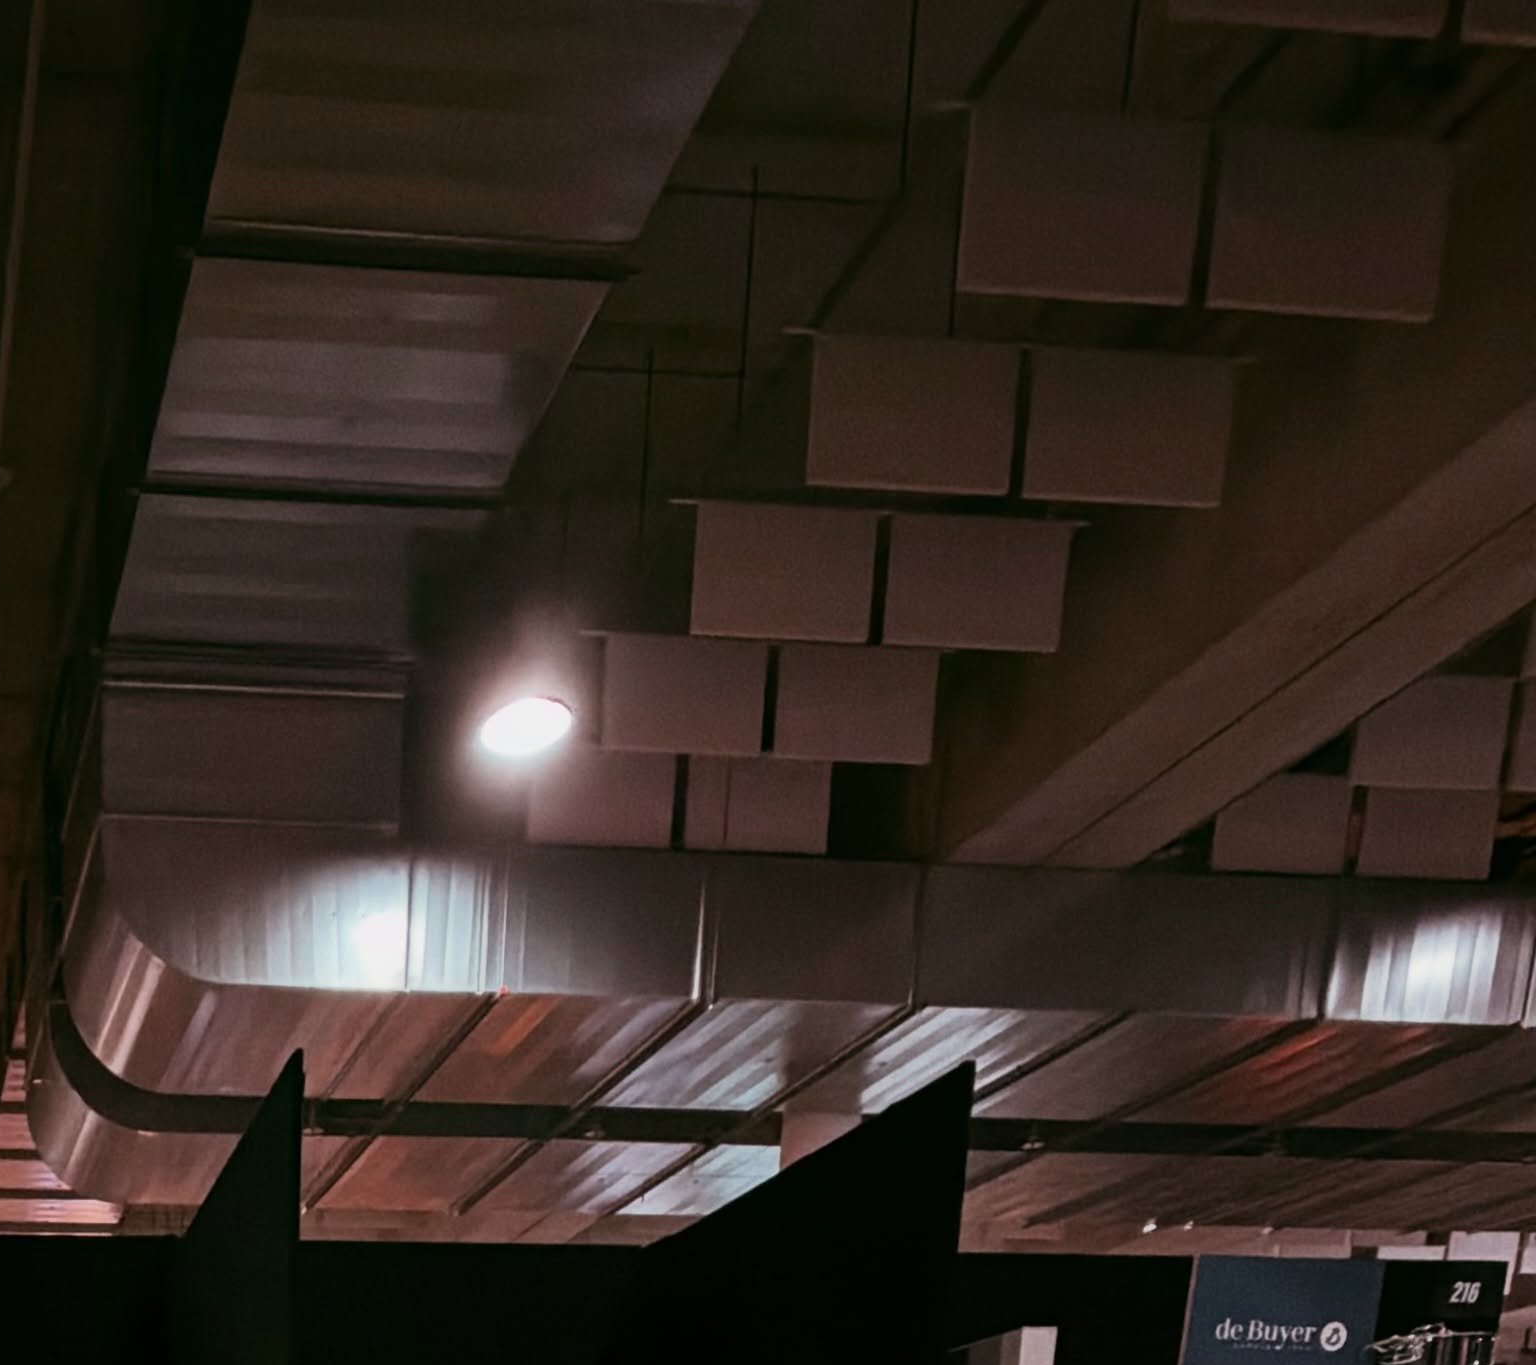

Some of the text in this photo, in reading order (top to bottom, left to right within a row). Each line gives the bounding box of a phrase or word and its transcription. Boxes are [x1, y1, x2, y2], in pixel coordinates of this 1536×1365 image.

[1449, 1281, 1481, 1303] 216
[1215, 1317, 1317, 1349] de Buyer
